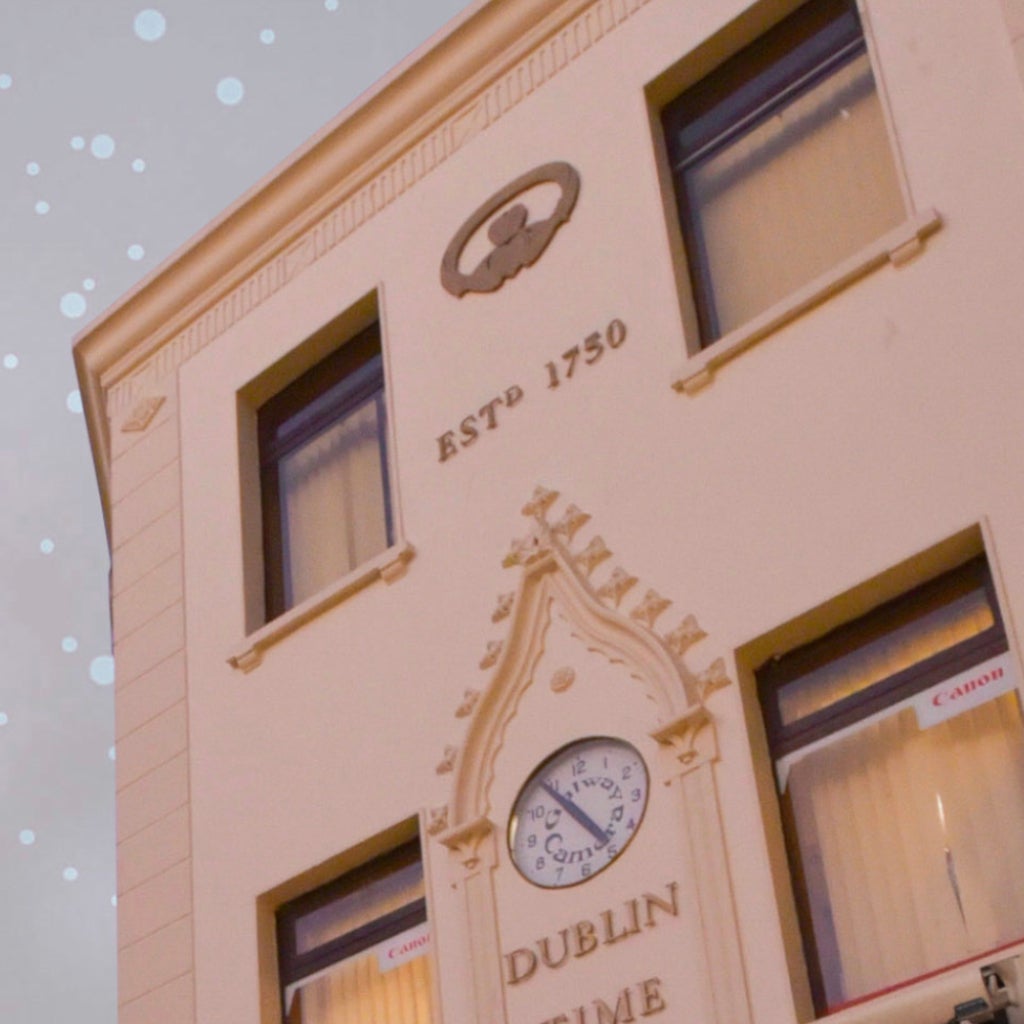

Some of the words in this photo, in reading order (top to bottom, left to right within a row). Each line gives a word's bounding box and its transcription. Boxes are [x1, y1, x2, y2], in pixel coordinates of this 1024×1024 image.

[544, 318, 626, 390] 1750
[932, 667, 1004, 707] Canon
[503, 881, 680, 985] DUBLIN
